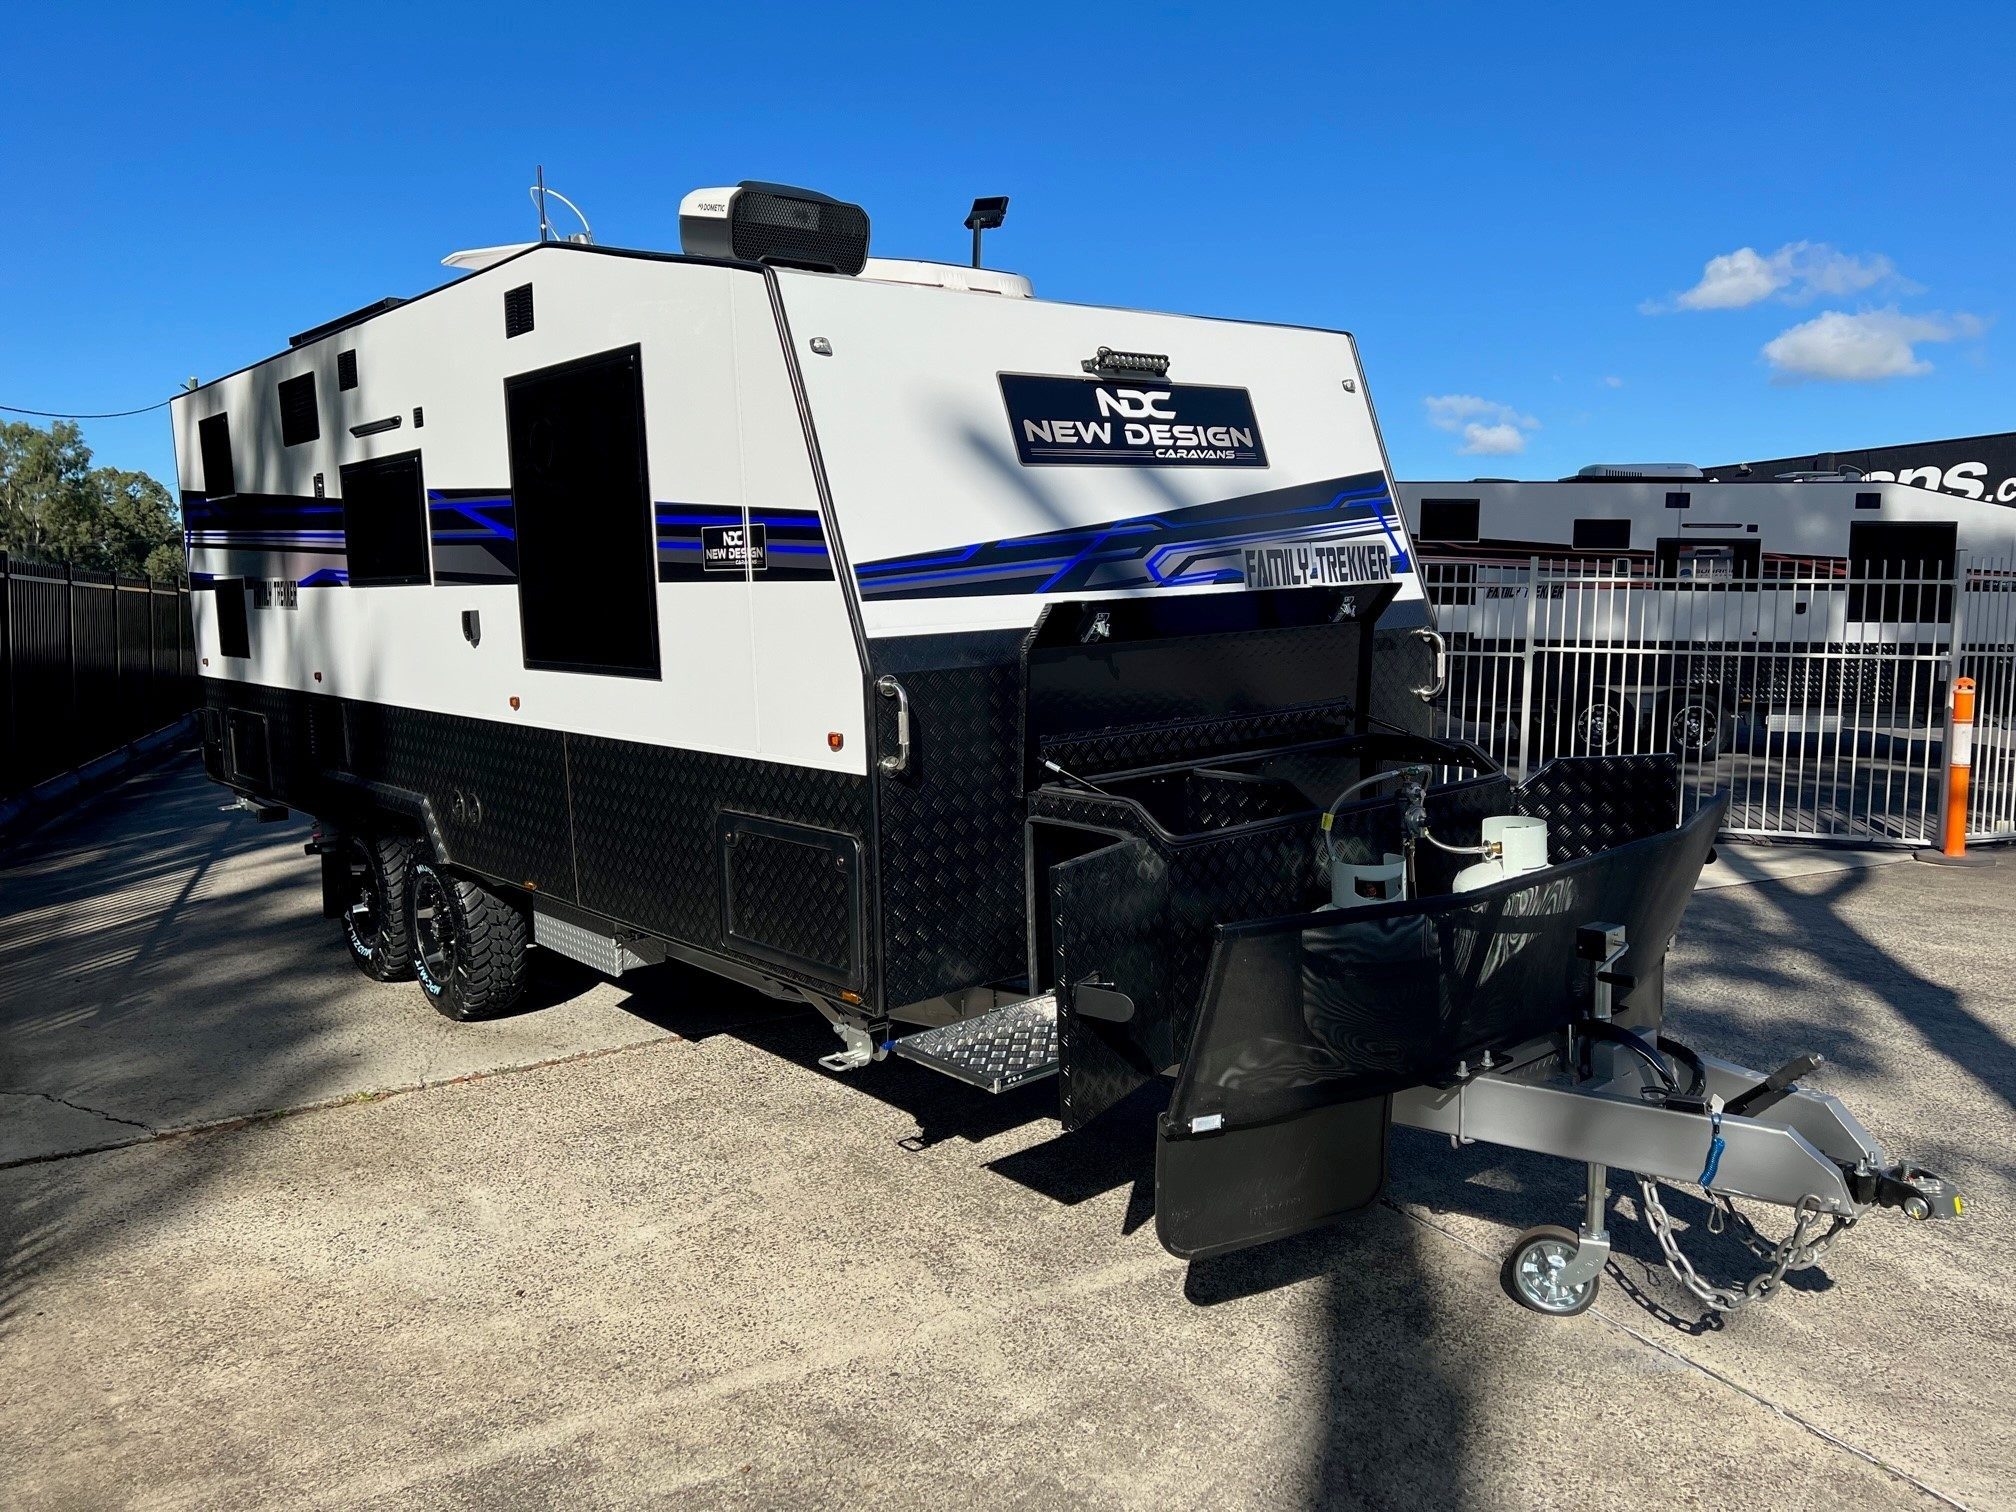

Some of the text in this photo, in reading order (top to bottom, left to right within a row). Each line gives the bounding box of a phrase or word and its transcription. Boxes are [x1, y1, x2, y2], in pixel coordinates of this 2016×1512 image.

[703, 203, 725, 212] DOMETIC
[1095, 387, 1177, 420] NDC
[1022, 419, 1254, 448] NEW DESIGN
[1154, 448, 1236, 459] CARAVANS
[722, 530, 743, 546] NDC
[706, 547, 763, 560] NEW DESGN
